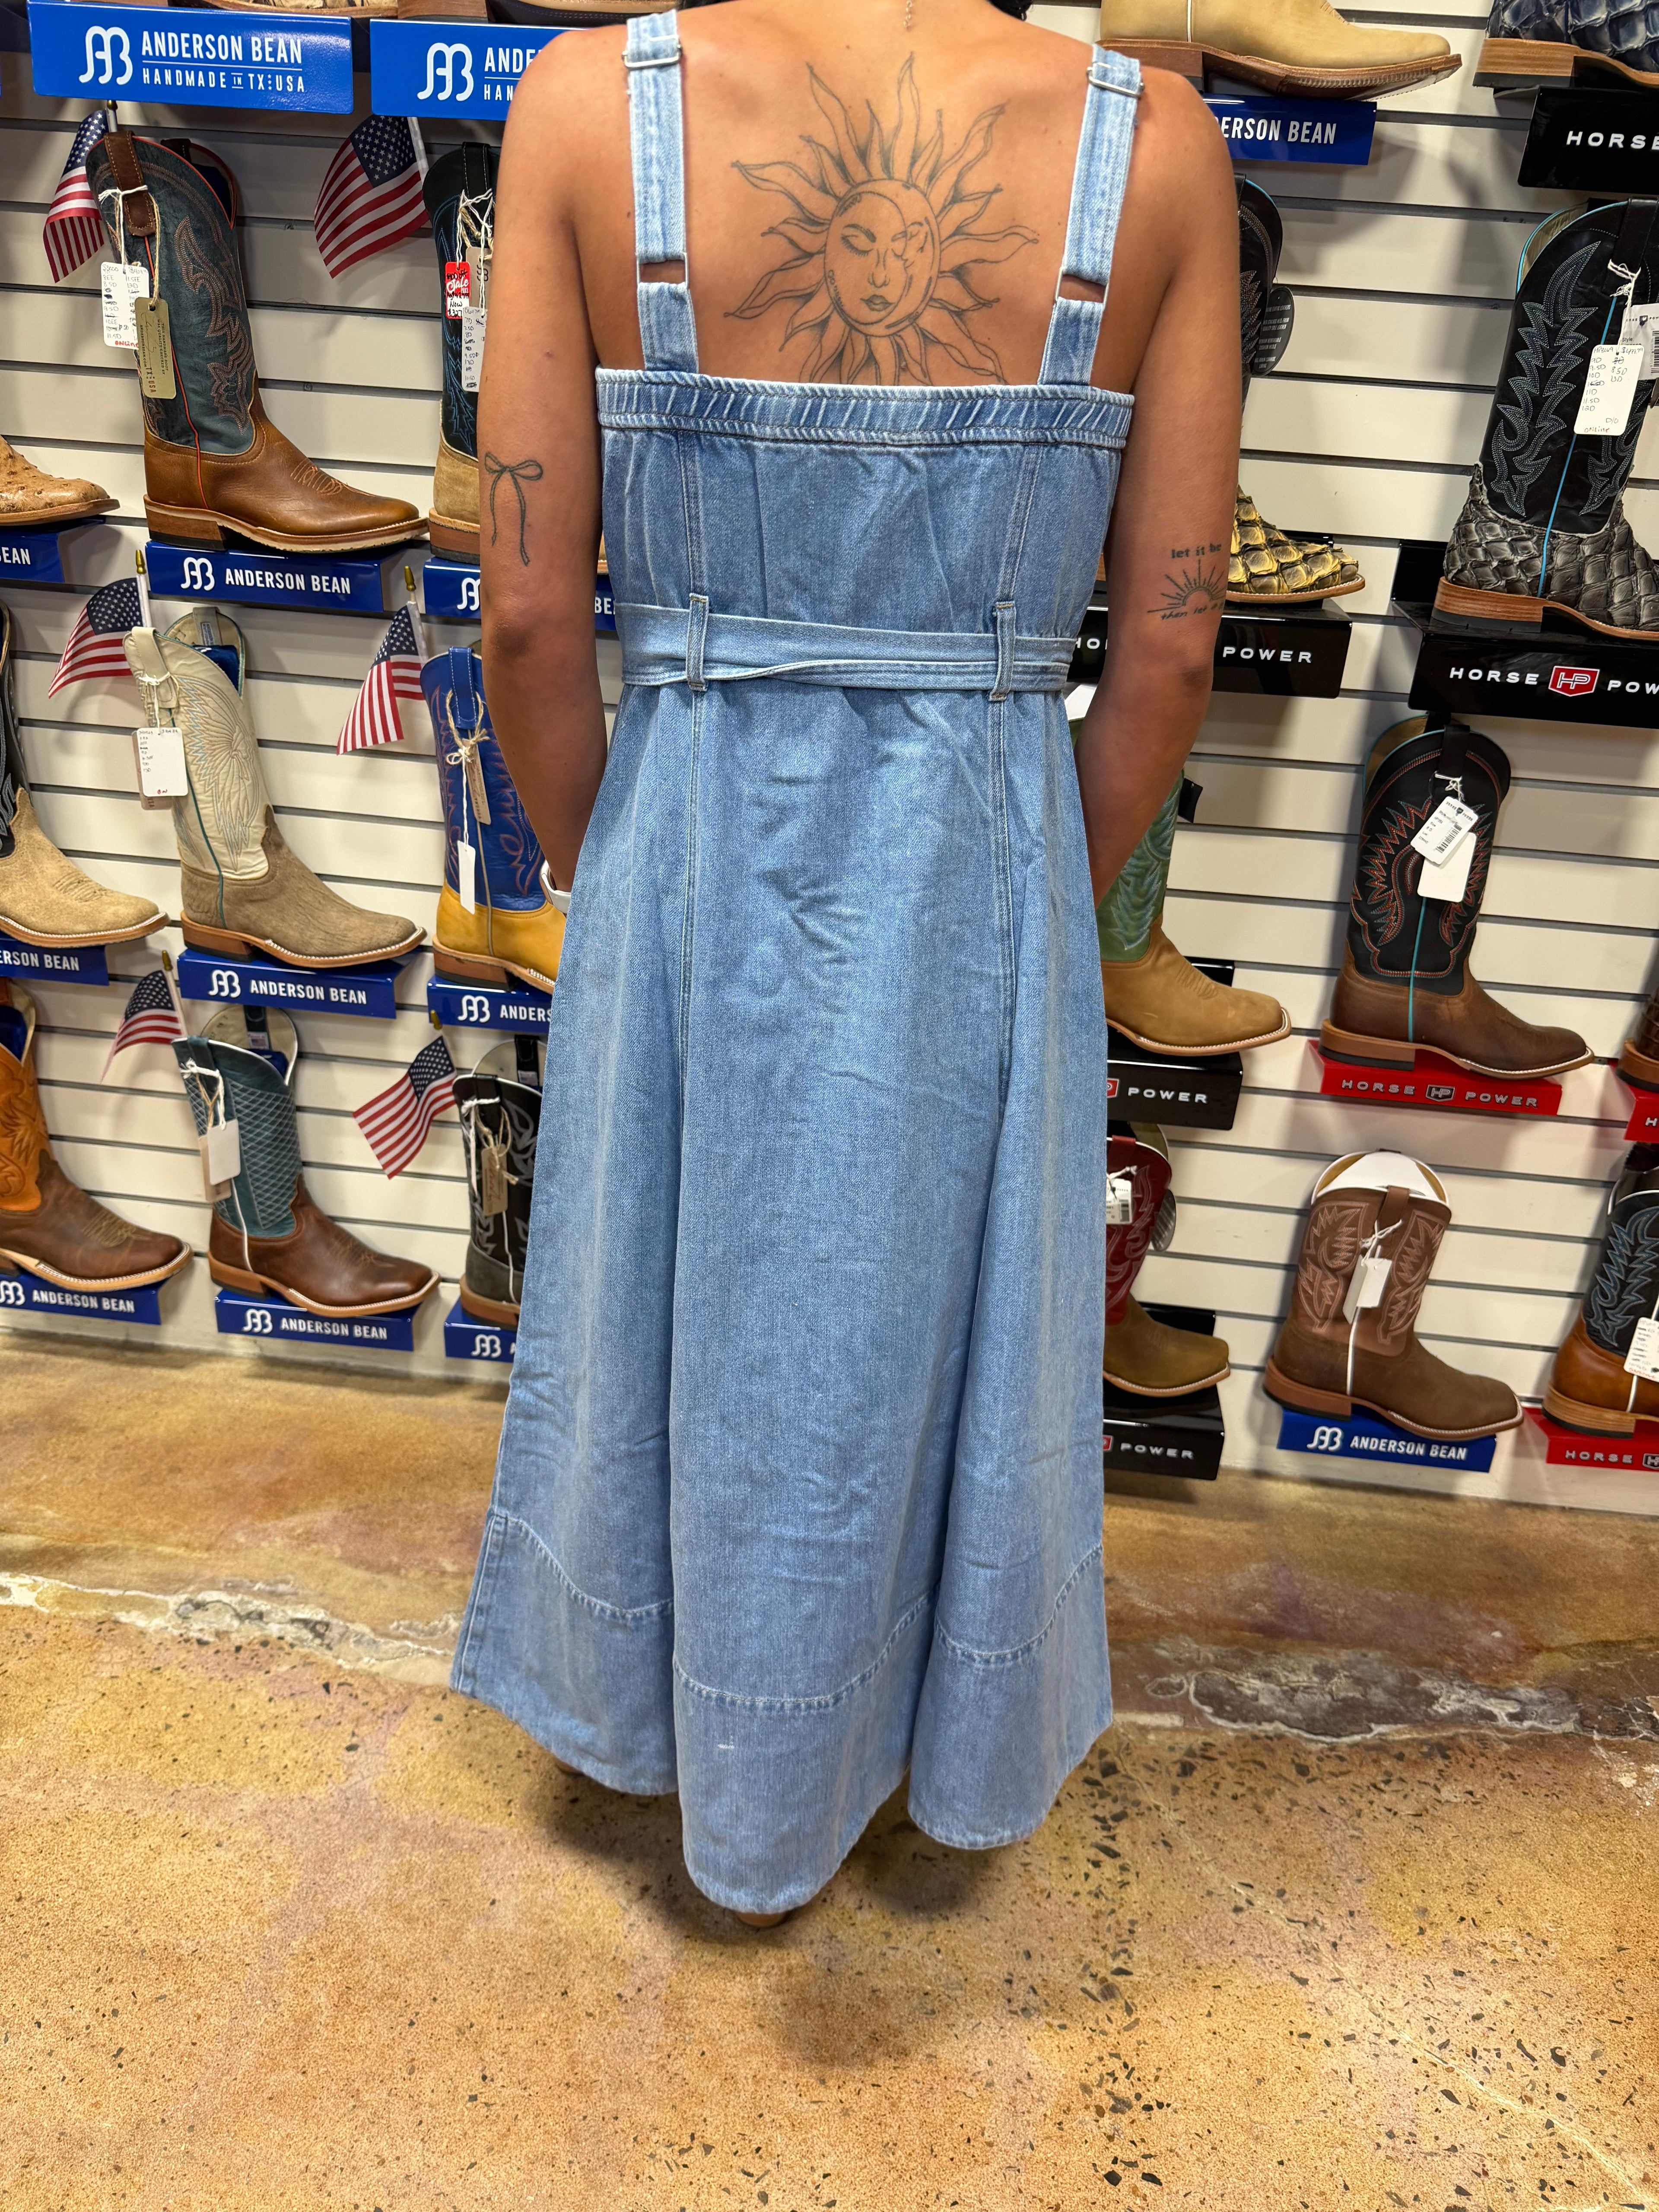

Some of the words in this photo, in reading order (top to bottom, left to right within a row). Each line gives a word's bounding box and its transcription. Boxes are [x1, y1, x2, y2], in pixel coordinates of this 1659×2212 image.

[142, 31, 243, 60] ANDERSON
[252, 37, 302, 64] BEAN
[484, 48, 542, 73] ANDE
[143, 68, 226, 88] HANDMADE
[233, 76, 242, 85] IN
[249, 74, 264, 90] TX
[276, 75, 304, 92] USA
[1215, 117, 1281, 141] ERSON
[1287, 121, 1336, 144] BEAN
[446, 276, 469, 294] Sale
[148, 380, 156, 393] USA
[1171, 549, 1189, 559] let
[1196, 546, 1205, 556] it
[1210, 543, 1222, 553] be
[226, 568, 305, 590] ANDERSON
[311, 575, 351, 594] BEAN
[1223, 647, 1312, 663] POWER
[1449, 667, 1539, 685] HORSE
[44, 953, 79, 971] BEAN
[251, 979, 324, 1000] ANDERSON
[330, 988, 367, 1004] BEAN
[1128, 1087, 1207, 1103] POWER
[1342, 1080, 1415, 1095] HORSE
[1465, 1091, 1538, 1107] POWER
[33, 1290, 99, 1309] ANDERSON
[102, 1297, 135, 1313] BEAN
[281, 1318, 349, 1336] ANDERSON
[354, 1325, 387, 1339] BEAN
[1120, 1443, 1194, 1460] POWER
[1350, 1435, 1425, 1457] ANDERSON
[1429, 1445, 1467, 1460] BEAN
[1565, 1449, 1633, 1464] HORSE
